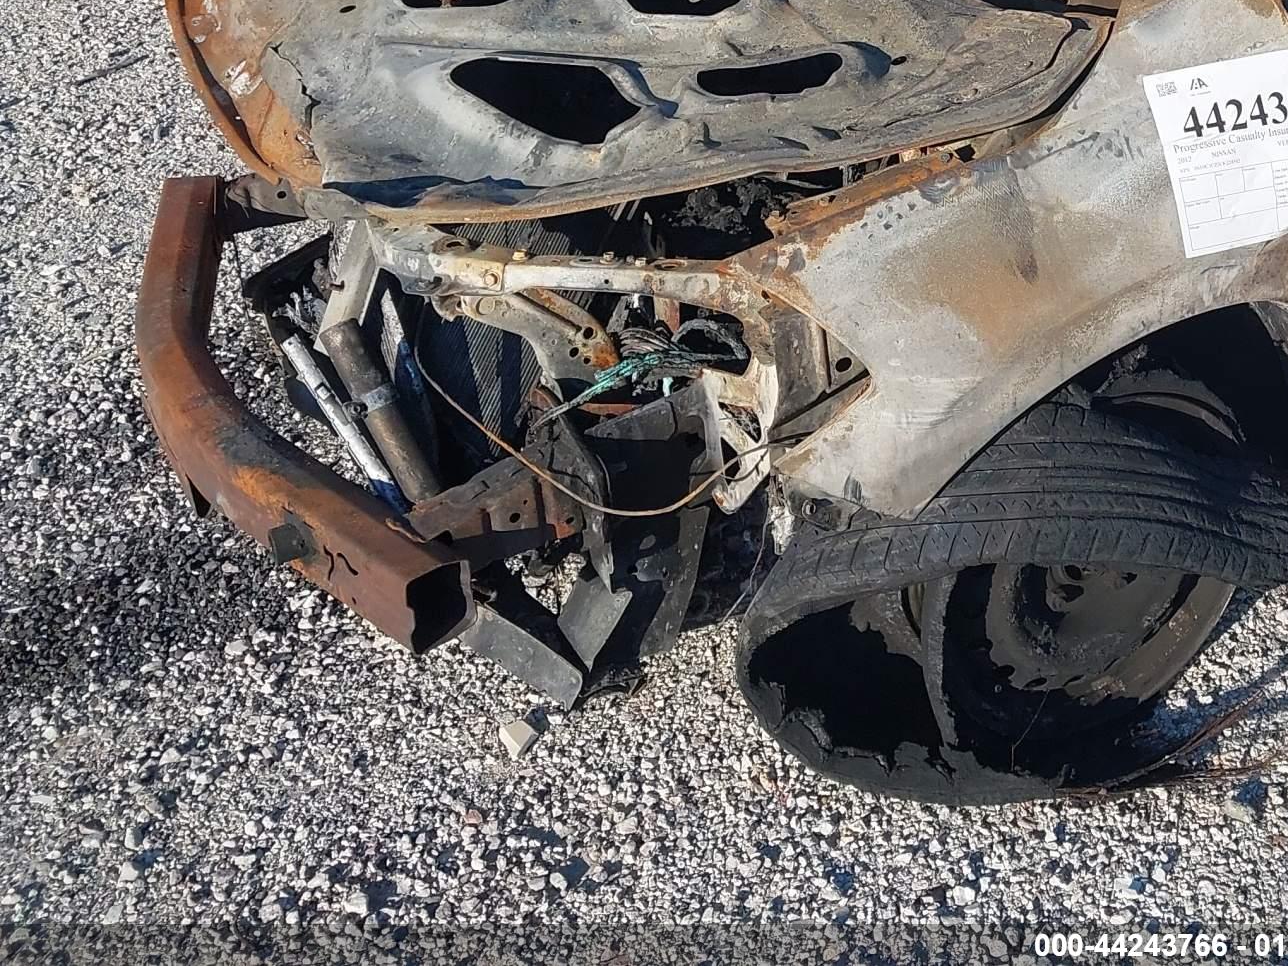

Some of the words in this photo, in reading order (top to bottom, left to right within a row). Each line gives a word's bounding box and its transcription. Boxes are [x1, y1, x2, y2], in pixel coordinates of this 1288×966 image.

[1173, 137, 1227, 154] Progressive
[1228, 129, 1266, 144] Casualty
[1211, 148, 1237, 158] NISSAN
